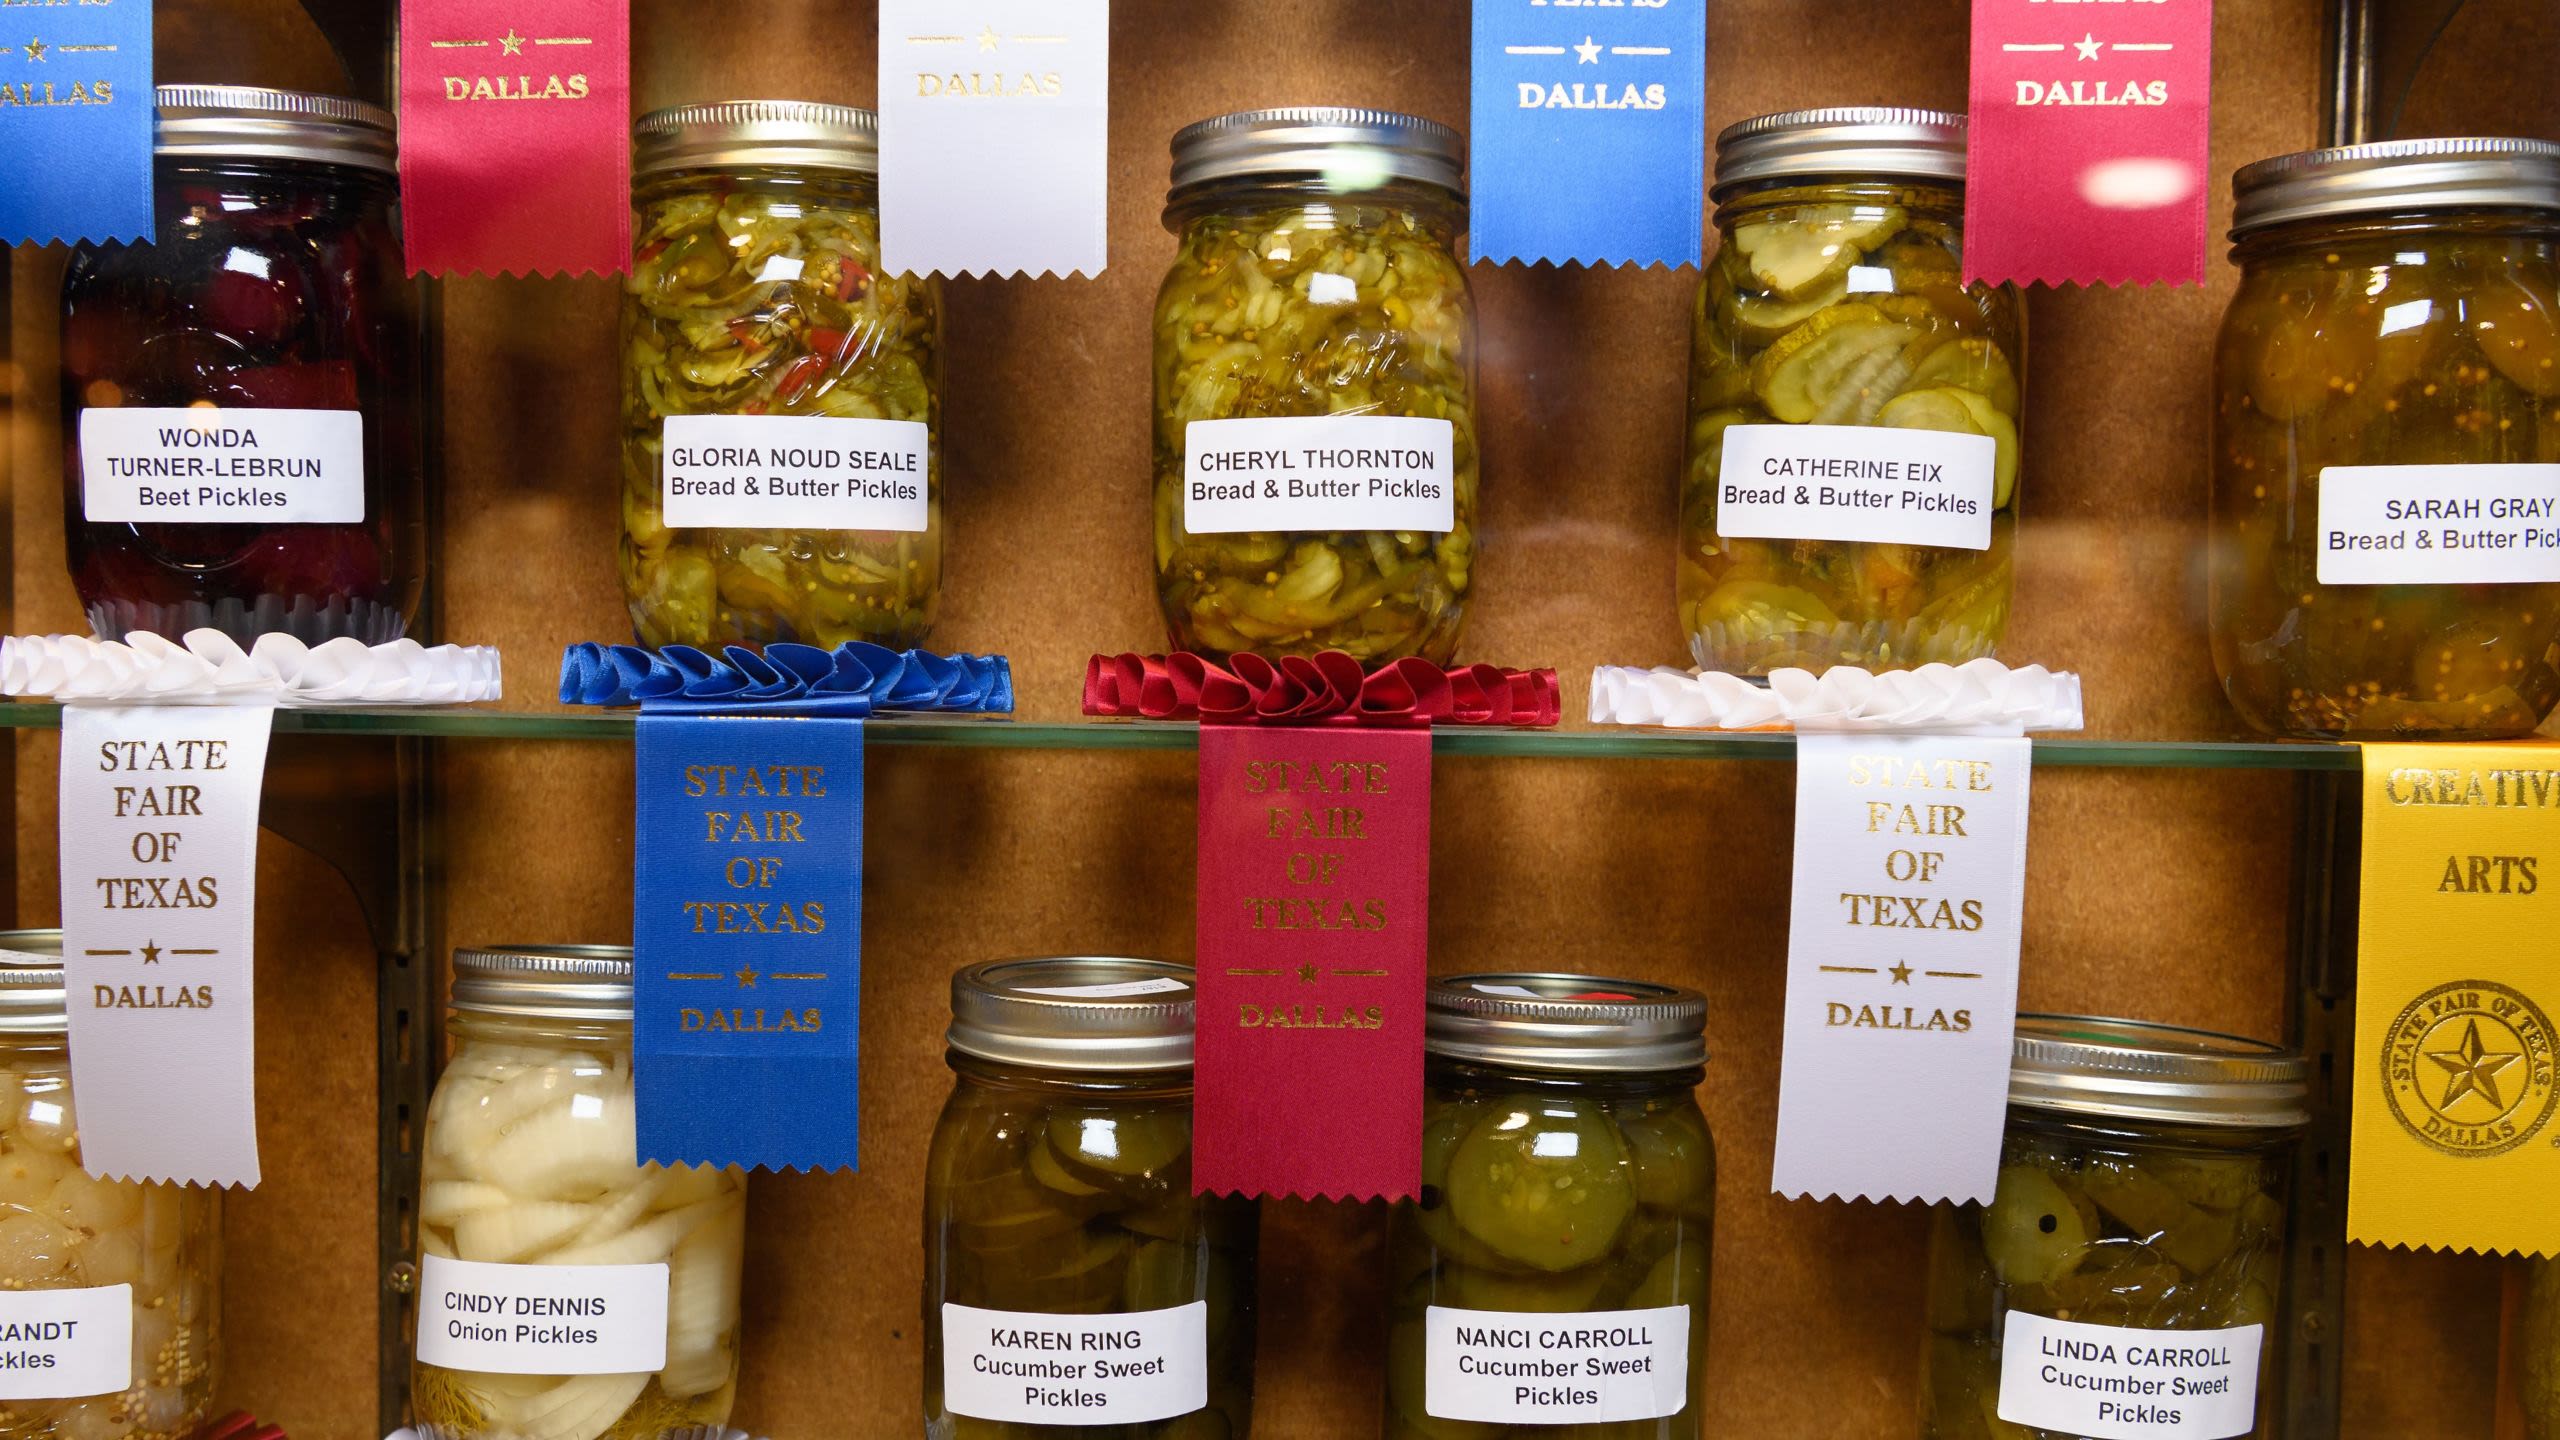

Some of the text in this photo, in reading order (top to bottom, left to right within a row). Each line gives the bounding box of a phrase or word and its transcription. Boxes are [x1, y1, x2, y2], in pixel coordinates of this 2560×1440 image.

[444, 74, 589, 100] DALLAS
[917, 72, 1063, 97] DALLAS
[1518, 82, 1667, 110] DALLAS
[2016, 80, 2168, 106] DALLAS
[159, 428, 258, 447] WONDA
[107, 458, 321, 477] TURNER-LEBRUN
[672, 448, 917, 472] GLORIA NOUD SEALE
[1200, 450, 1434, 471] CHERYL THORNTON
[1764, 458, 1942, 482] CATHERINE EIX
[139, 487, 287, 506] Beet Pickles
[672, 477, 917, 500] Bread & Butter Pickles
[1192, 479, 1440, 500] Bread & Butter Pickles
[1725, 486, 1977, 515] Bread & Butter Pickles
[2386, 498, 2555, 519] SARAH GRAY
[2330, 531, 2405, 550] Bread
[2415, 530, 2432, 549] &
[2443, 529, 2518, 549] Butter
[100, 740, 227, 772] STATE
[684, 765, 827, 797] STATE
[1245, 761, 1389, 793] STATE
[1848, 755, 1993, 792] STATE
[114, 785, 203, 816] FAIR
[2386, 768, 2560, 808] CREATIV
[704, 811, 806, 842] FAIR
[1266, 807, 1367, 839] FAIR
[1866, 801, 1967, 836] FAIR
[132, 832, 181, 862] OF
[726, 857, 783, 888] OF
[1286, 852, 1344, 885] OF
[1885, 850, 1944, 881] OF
[2437, 856, 2537, 894] ARTS
[97, 877, 218, 909] TEXAS
[684, 901, 826, 934] TEXAS
[1244, 898, 1388, 931] TEXAS
[1840, 893, 1983, 931] TEXAS
[95, 985, 213, 1009] DALLAS
[680, 1008, 822, 1032] DALLAS
[1239, 1005, 1384, 1030] DALLAS
[1826, 1002, 1971, 1032] DALLAS
[2392, 1013, 2427, 1081] STATE
[2428, 992, 2480, 1019] FAIR
[2492, 997, 2521, 1018] OF
[2423, 1116, 2516, 1146] DALLAS
[445, 1292, 606, 1316] CINDY DENNIS
[0, 1321, 77, 1342] ANDT
[448, 1320, 598, 1344] Onion Pickles
[991, 1328, 1141, 1350] KAREN RING
[1457, 1327, 1652, 1349] NANCI CARROLL
[2042, 1336, 2231, 1367] LINDA CARROLL
[973, 1354, 1164, 1379] Cucumber Sweet
[1459, 1356, 1651, 1377] Cucumber Sweet
[2041, 1365, 2229, 1396] Cucumber Sweet
[1026, 1387, 1107, 1407] Pickles
[1516, 1387, 1598, 1405] Pickles
[2099, 1402, 2181, 1424] Pickles
